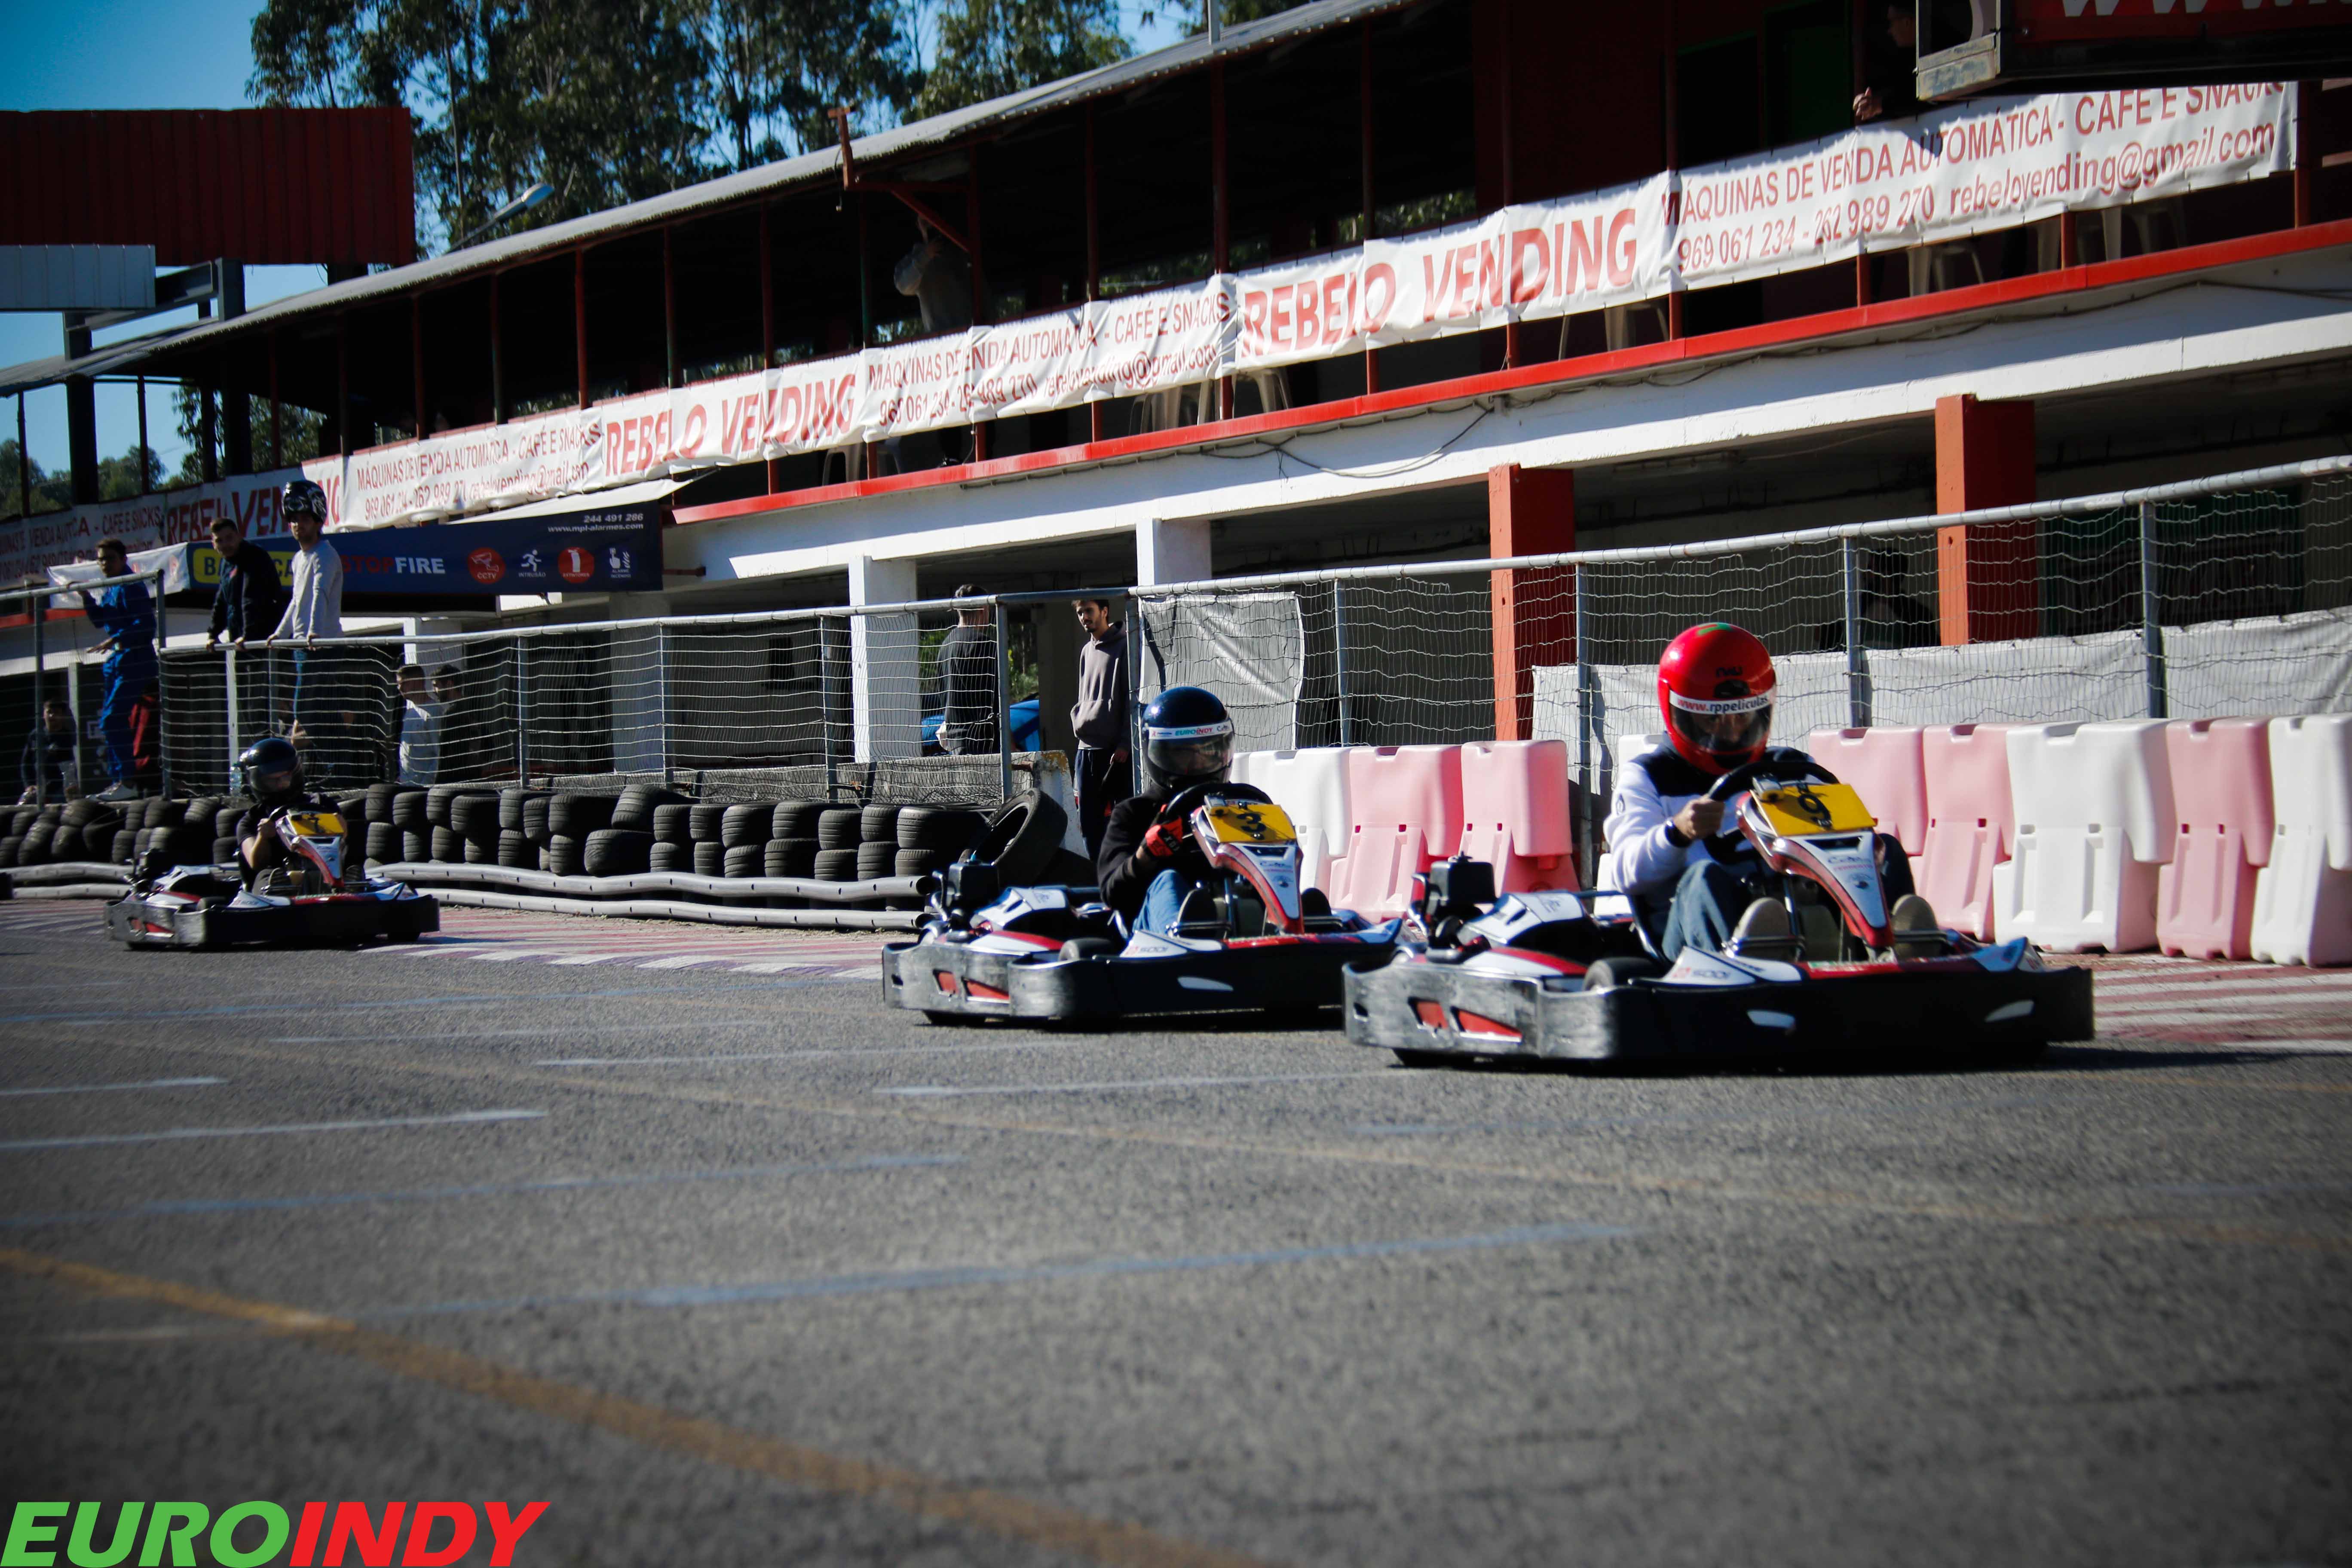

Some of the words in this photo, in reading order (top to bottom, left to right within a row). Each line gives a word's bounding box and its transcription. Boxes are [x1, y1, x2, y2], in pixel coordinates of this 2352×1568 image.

[1786, 161, 1814, 204] DE
[1819, 143, 1895, 194] VENDA
[1899, 105, 2053, 177] AUTOMÁTICA
[2161, 87, 2177, 120] E
[1678, 233, 1714, 273] 969
[1719, 224, 1754, 265] 061
[1760, 215, 1797, 257] 234
[1814, 204, 1842, 245] 262
[1848, 195, 1890, 235] 989
[1897, 184, 1935, 227] 270
[1950, 122, 2275, 215] rebelovending@gmail.com
[1240, 262, 1397, 359] REBELO
[1423, 208, 1636, 322] VENDING
[1115, 300, 1154, 344] CAFÉ
[1158, 306, 1168, 336] E
[1173, 292, 1230, 334] SNACKS
[606, 404, 707, 477] REBELO
[721, 374, 856, 454] VENDING
[906, 393, 928, 423] 061
[518, 426, 547, 459] CAFÉ
[550, 430, 557, 454] E
[548, 523, 644, 533] www.mpl-alarmes.com
[584, 514, 602, 523] 244
[605, 514, 622, 522] 491
[625, 513, 643, 522] 286
